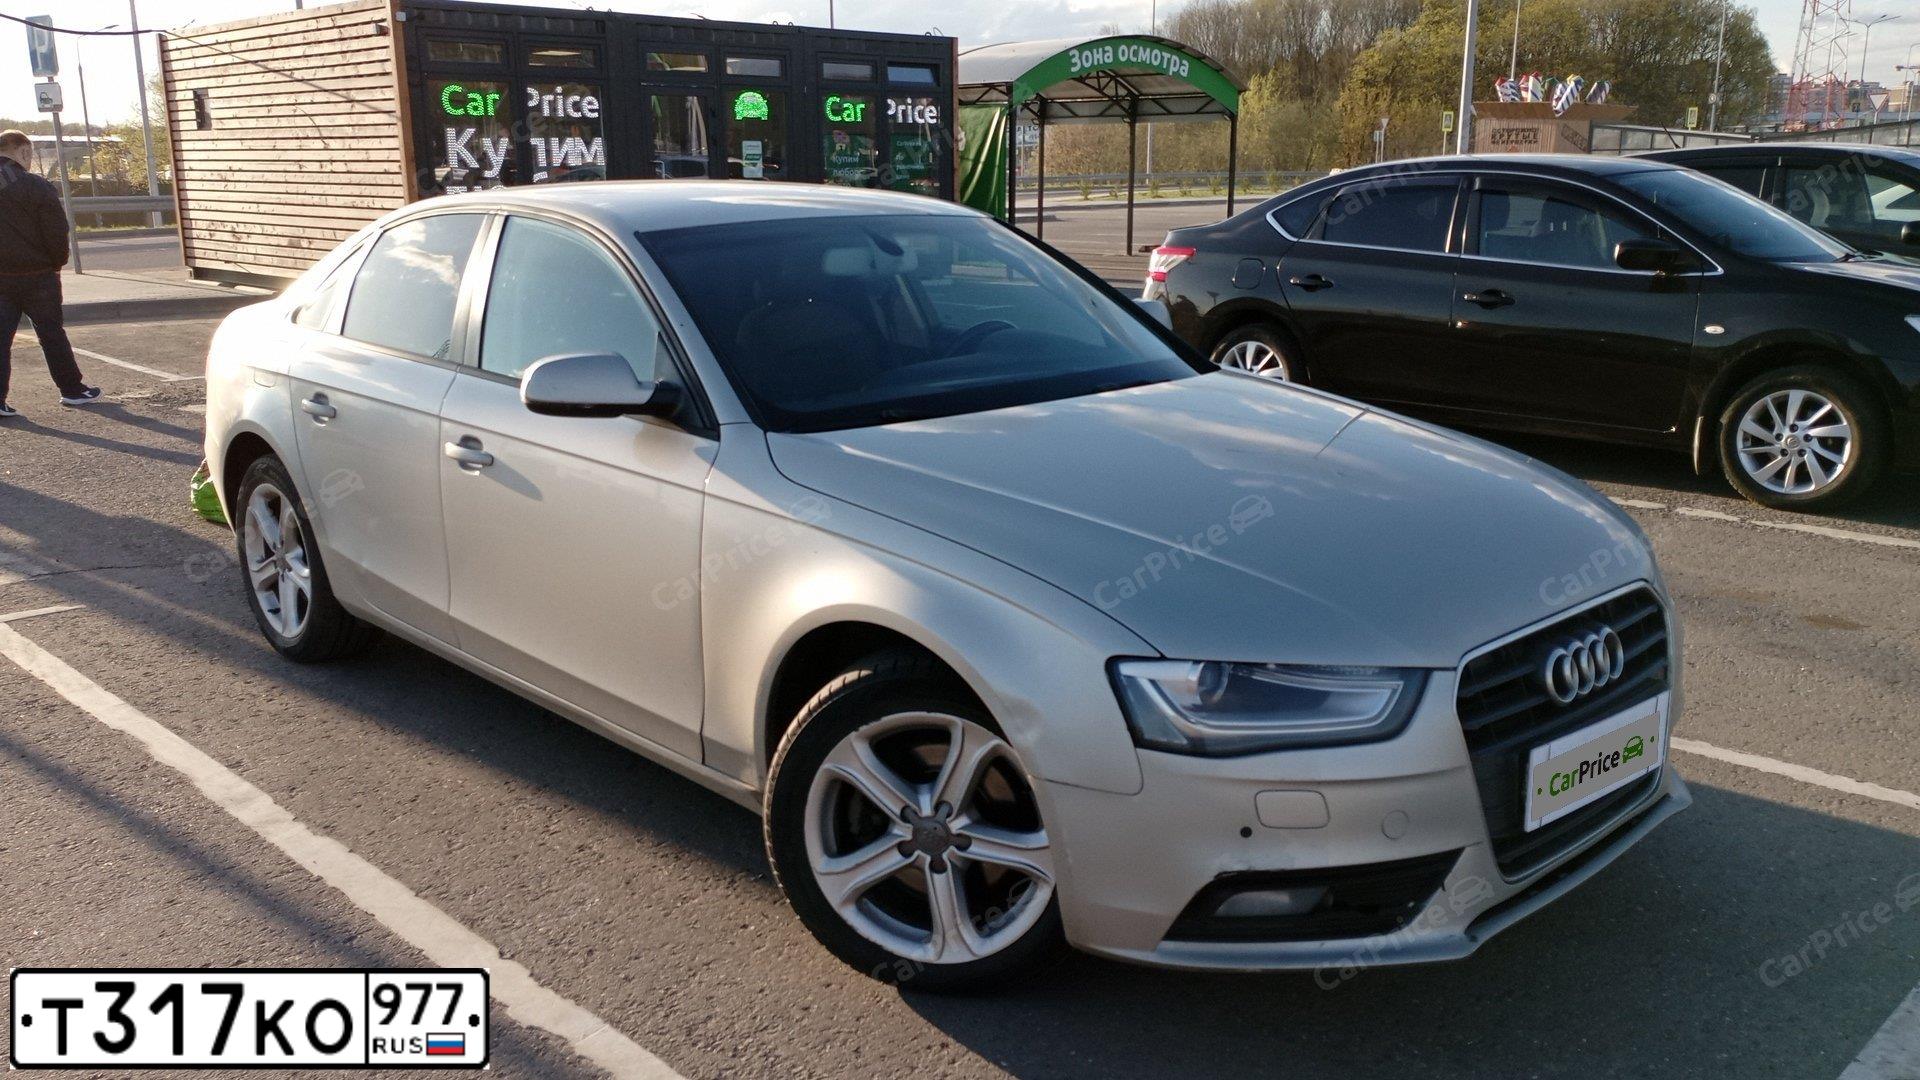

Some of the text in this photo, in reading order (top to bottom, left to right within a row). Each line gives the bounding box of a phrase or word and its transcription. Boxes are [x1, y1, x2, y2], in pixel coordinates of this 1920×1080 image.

[1069, 45, 1190, 78] Зона осмотра
[441, 81, 500, 117] Car
[825, 95, 867, 123] Car
